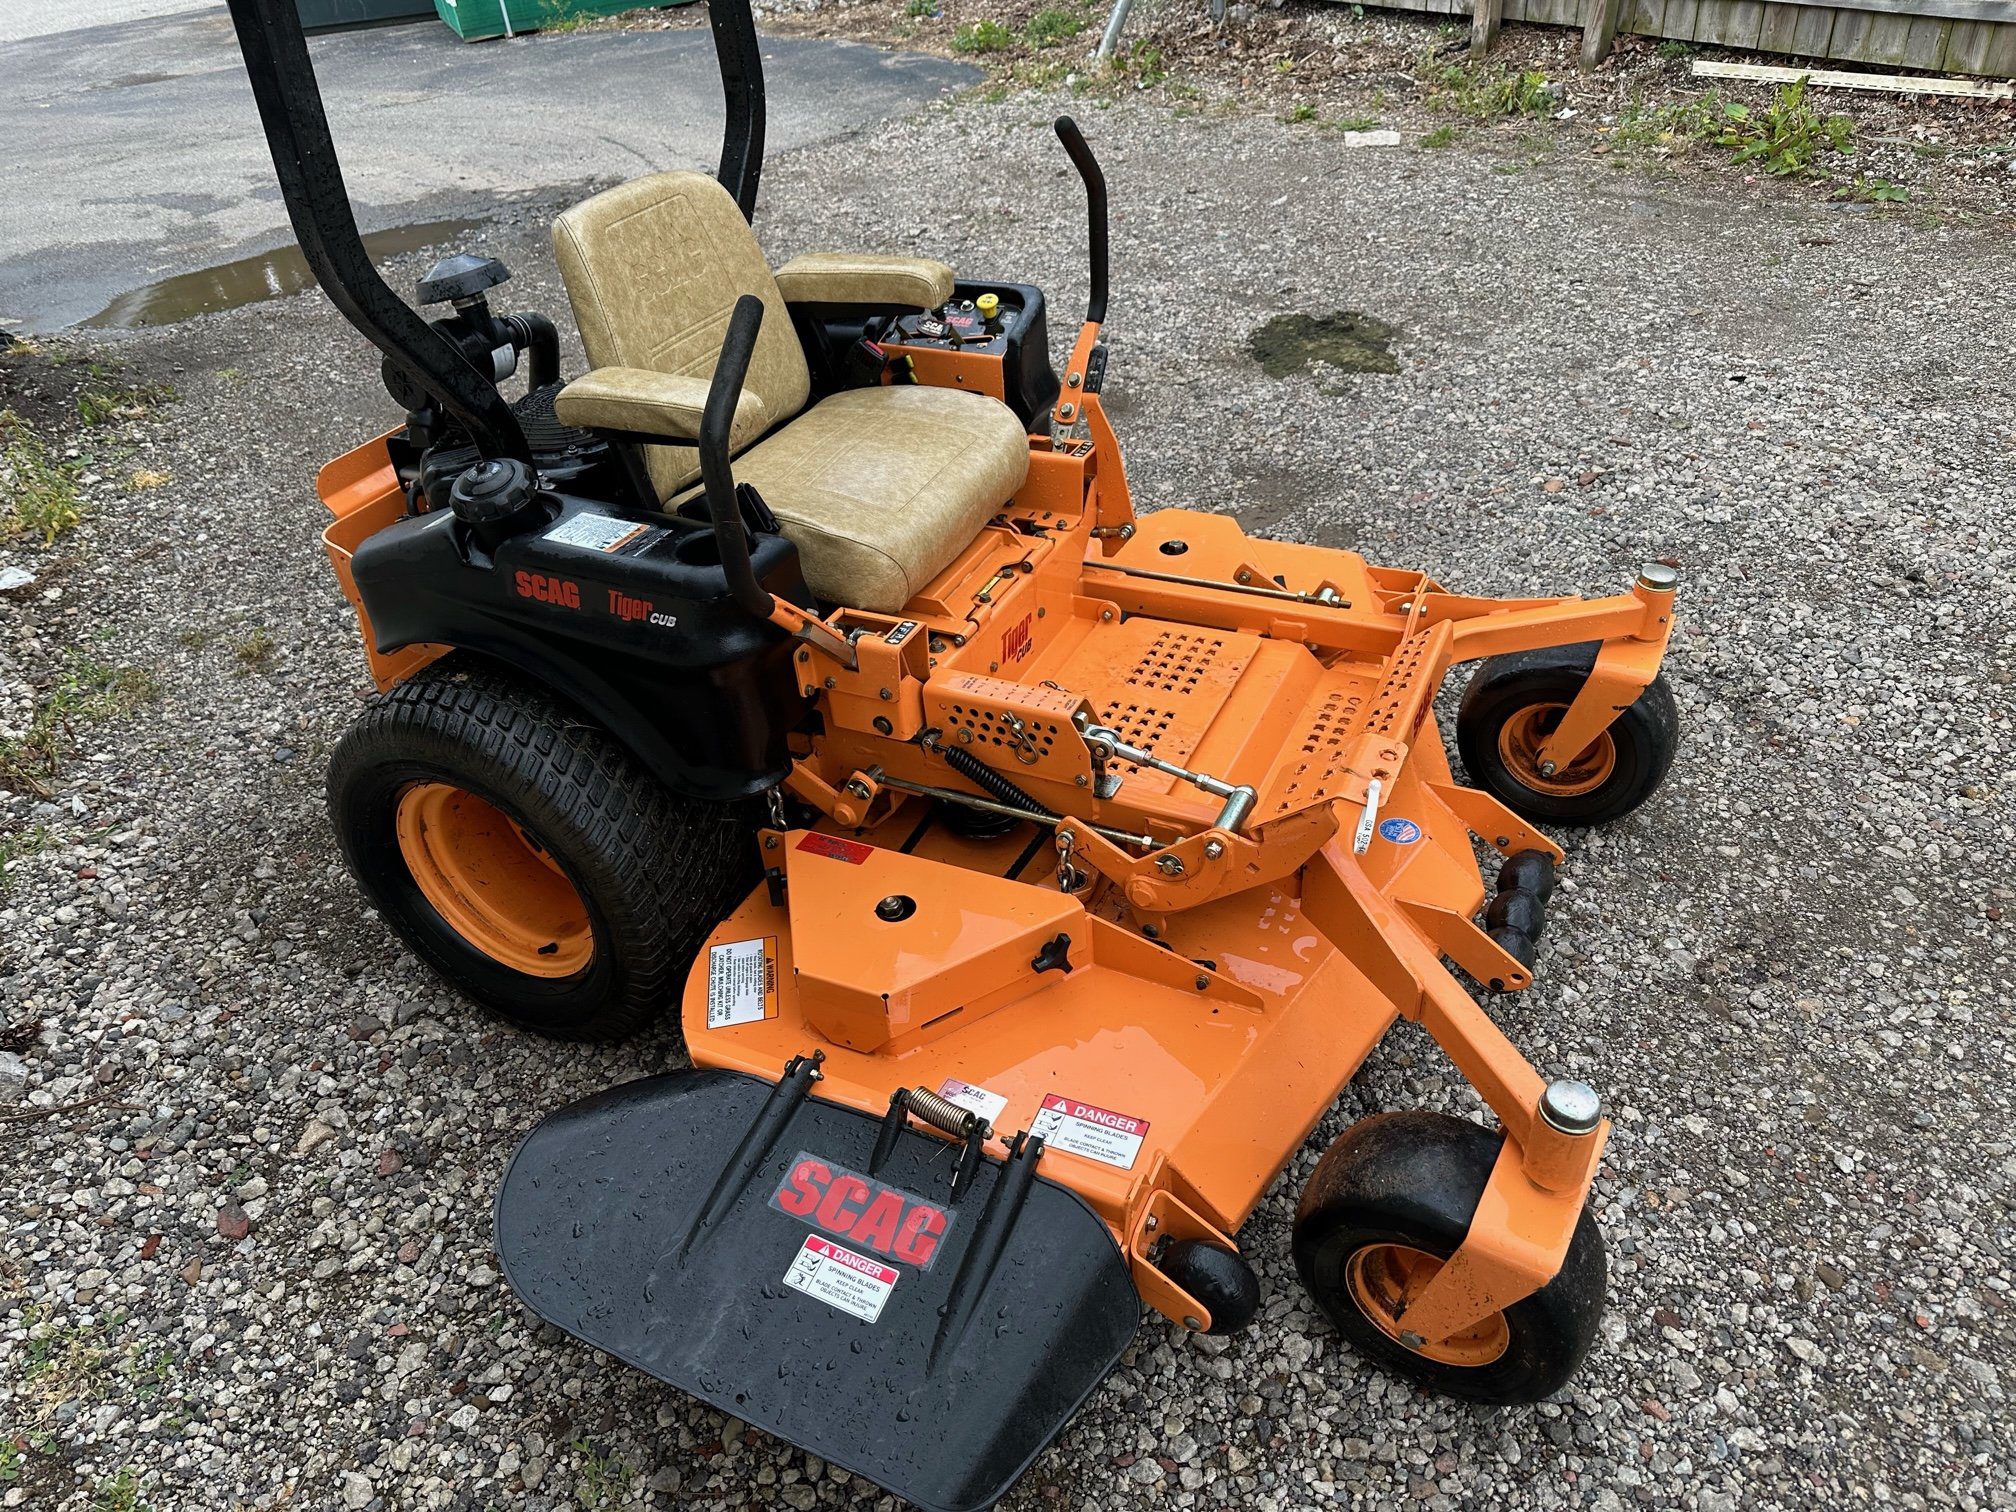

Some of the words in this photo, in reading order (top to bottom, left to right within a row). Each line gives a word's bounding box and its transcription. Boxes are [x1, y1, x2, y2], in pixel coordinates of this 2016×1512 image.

[944, 316, 973, 327] SCAG
[514, 570, 581, 609] SCAG
[608, 589, 653, 622] Tiger
[649, 612, 677, 627] CUB
[1001, 612, 1032, 664] Tiger
[766, 964, 774, 994] WARNING
[1074, 1105, 1138, 1133] DANGER
[1075, 1121, 1104, 1134] SPINNING
[1104, 1130, 1129, 1141] BLADES
[1069, 1143, 1090, 1153] OBJECTS
[1079, 1141, 1101, 1151] CONTACT
[1096, 1137, 1113, 1145] CLEAR
[778, 1160, 947, 1266] SCAG
[832, 1248, 884, 1279] DANGER
[828, 1266, 857, 1283] SPINNING
[857, 1278, 881, 1293] BLADES
[836, 1279, 849, 1288] KEEP
[849, 1284, 865, 1295] CLEAR
[815, 1278, 831, 1289] BLADE
[830, 1285, 852, 1298] CONTACT
[856, 1296, 877, 1310] THROWN
[820, 1286, 841, 1299] OBJECTS
[840, 1295, 851, 1303] CAN
